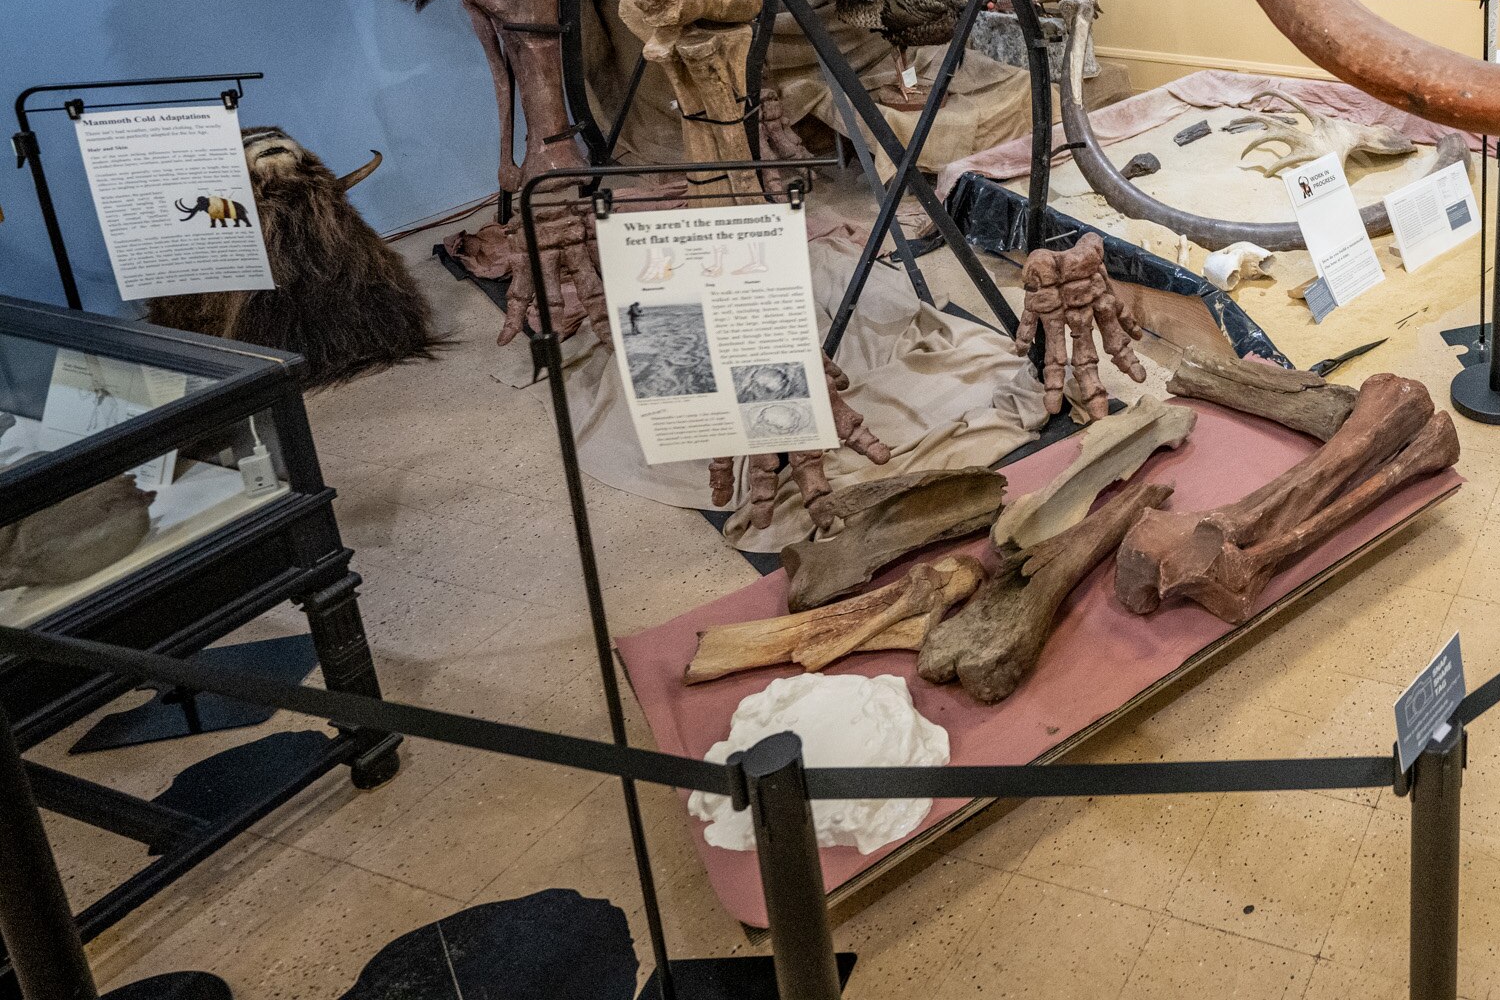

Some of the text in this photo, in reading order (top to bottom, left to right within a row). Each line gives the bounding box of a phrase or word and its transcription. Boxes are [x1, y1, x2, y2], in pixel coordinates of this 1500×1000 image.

[82, 113, 211, 127] Mammoth Cold Adaptations
[1310, 172, 1324, 181] WORK
[1313, 175, 1336, 188] PROGRESS
[624, 214, 781, 233] Why aren't the mammoth's
[626, 227, 783, 246] feet flat against the ground?
[1433, 660, 1452, 687] SHARE
[1435, 679, 1447, 696] TAG
